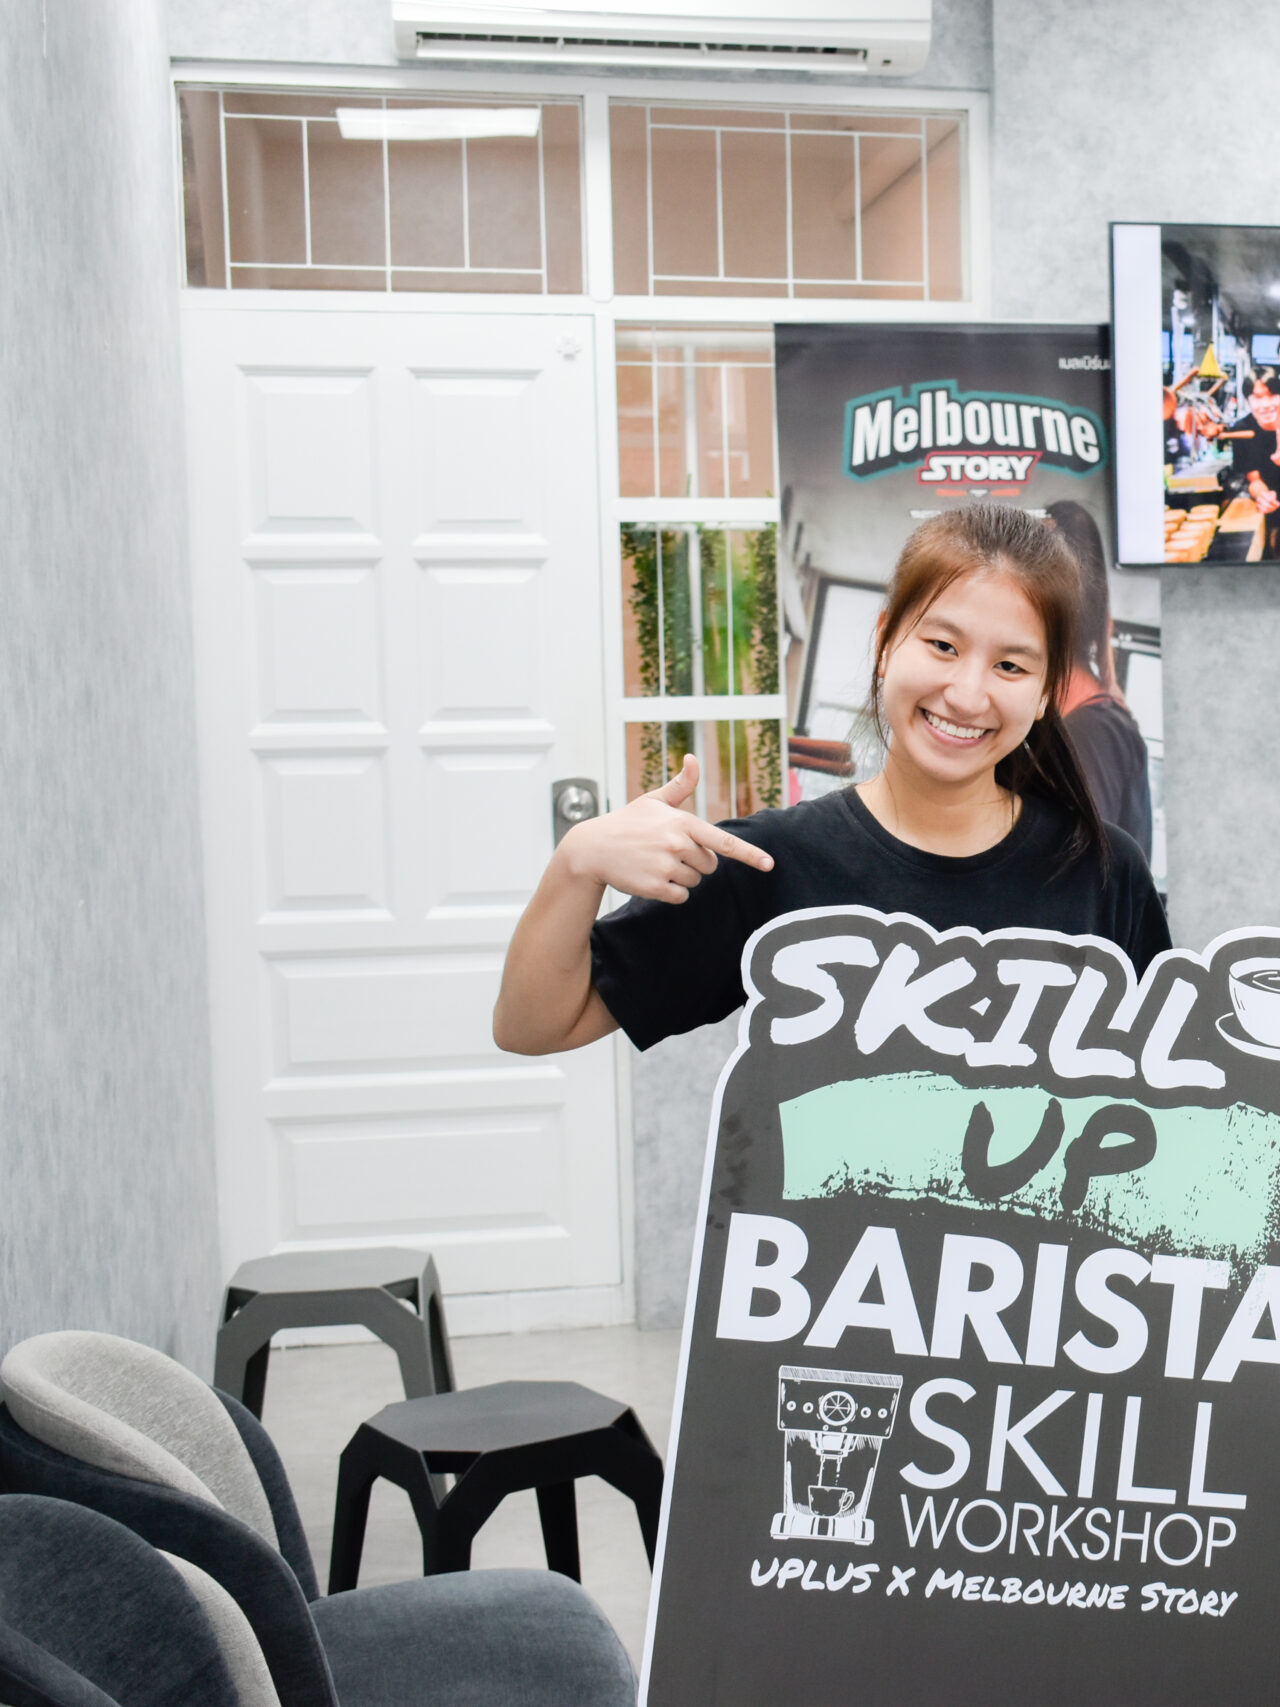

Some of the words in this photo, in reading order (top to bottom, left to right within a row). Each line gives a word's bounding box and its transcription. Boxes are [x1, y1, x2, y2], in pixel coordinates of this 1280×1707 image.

[852, 390, 1100, 466] Melbourne
[920, 456, 1034, 481] STORY
[771, 935, 1226, 1089] SKILL
[962, 1097, 1157, 1211] UP
[899, 1377, 1248, 1510] SKILL
[900, 1494, 1236, 1568] WORKSHOP
[750, 1559, 878, 1593] UPLUS
